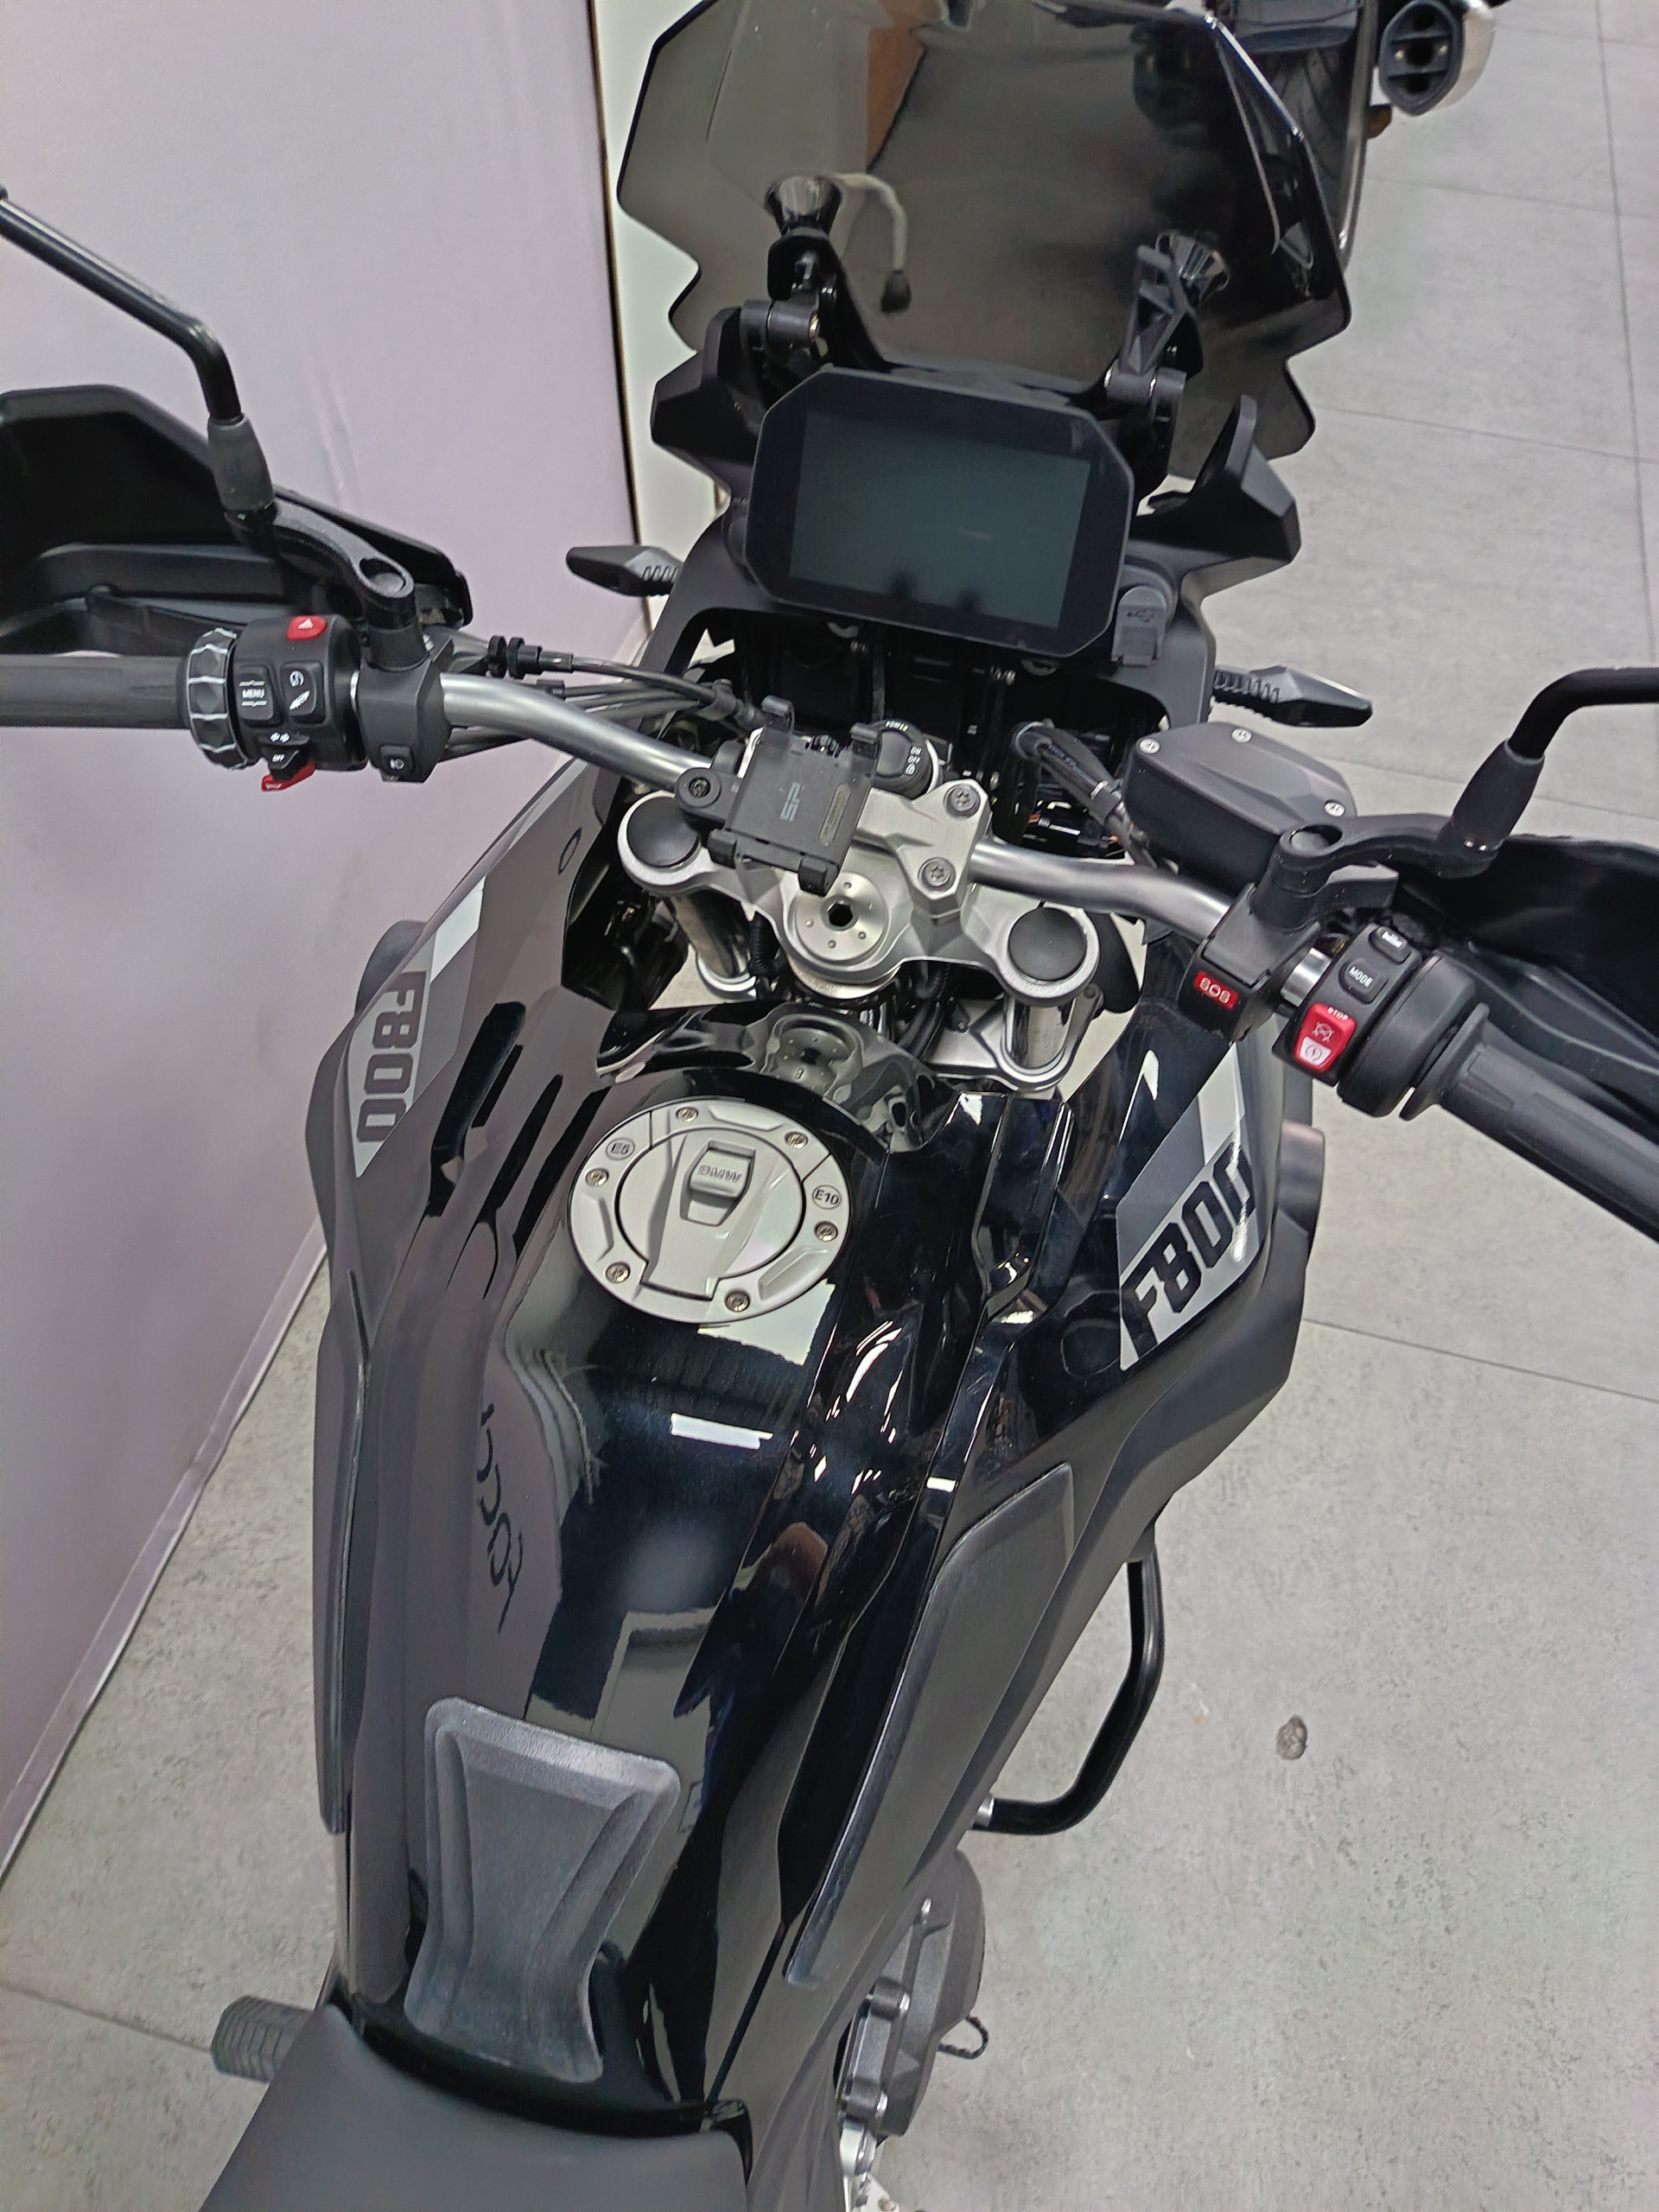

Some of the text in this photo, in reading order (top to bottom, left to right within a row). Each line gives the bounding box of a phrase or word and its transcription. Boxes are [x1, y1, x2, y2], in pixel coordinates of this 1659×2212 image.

[910, 746, 922, 755] ON
[779, 781, 801, 823] SP
[1348, 966, 1374, 988] MODE
[1198, 977, 1231, 1004] SOS
[1326, 1006, 1349, 1021] STOP
[356, 970, 427, 1143] F800
[610, 1141, 631, 1155] E5
[697, 1164, 743, 1183] BMW
[814, 1188, 840, 1205] E10
[1121, 1142, 1257, 1362] F800
